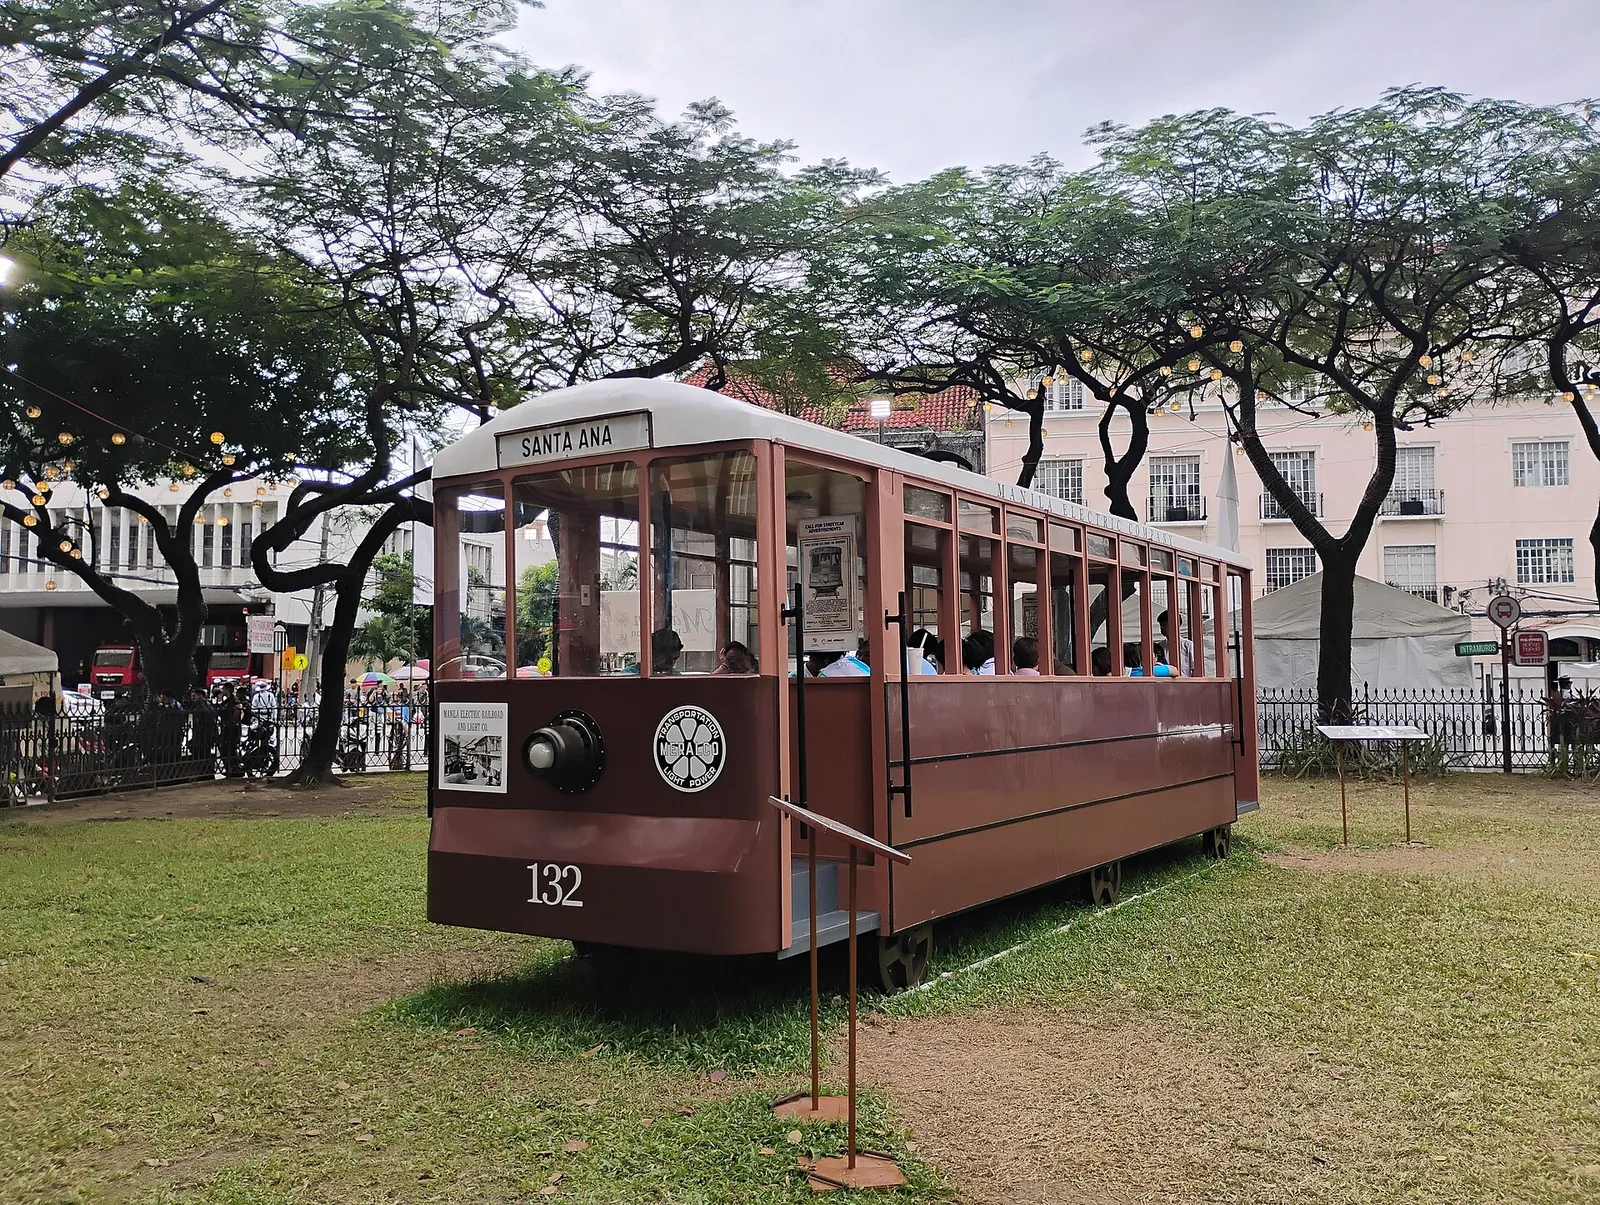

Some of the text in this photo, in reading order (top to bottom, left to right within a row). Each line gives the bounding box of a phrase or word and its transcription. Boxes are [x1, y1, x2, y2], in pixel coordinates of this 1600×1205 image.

[522, 425, 612, 458] SANTA ANA
[997, 483, 1173, 546] MANILA ELECTRIC COMPANY
[1459, 644, 1497, 654] INTRAMUROS
[443, 710, 504, 720] MANILA ELECTRIC RAILROAD
[659, 710, 720, 739] TRANSPORTATION
[457, 722, 467, 732] AND
[467, 722, 481, 732] LIGHT
[660, 741, 719, 757] MERALCO
[663, 766, 716, 787] LIGHT POWER
[526, 862, 584, 907] 132
